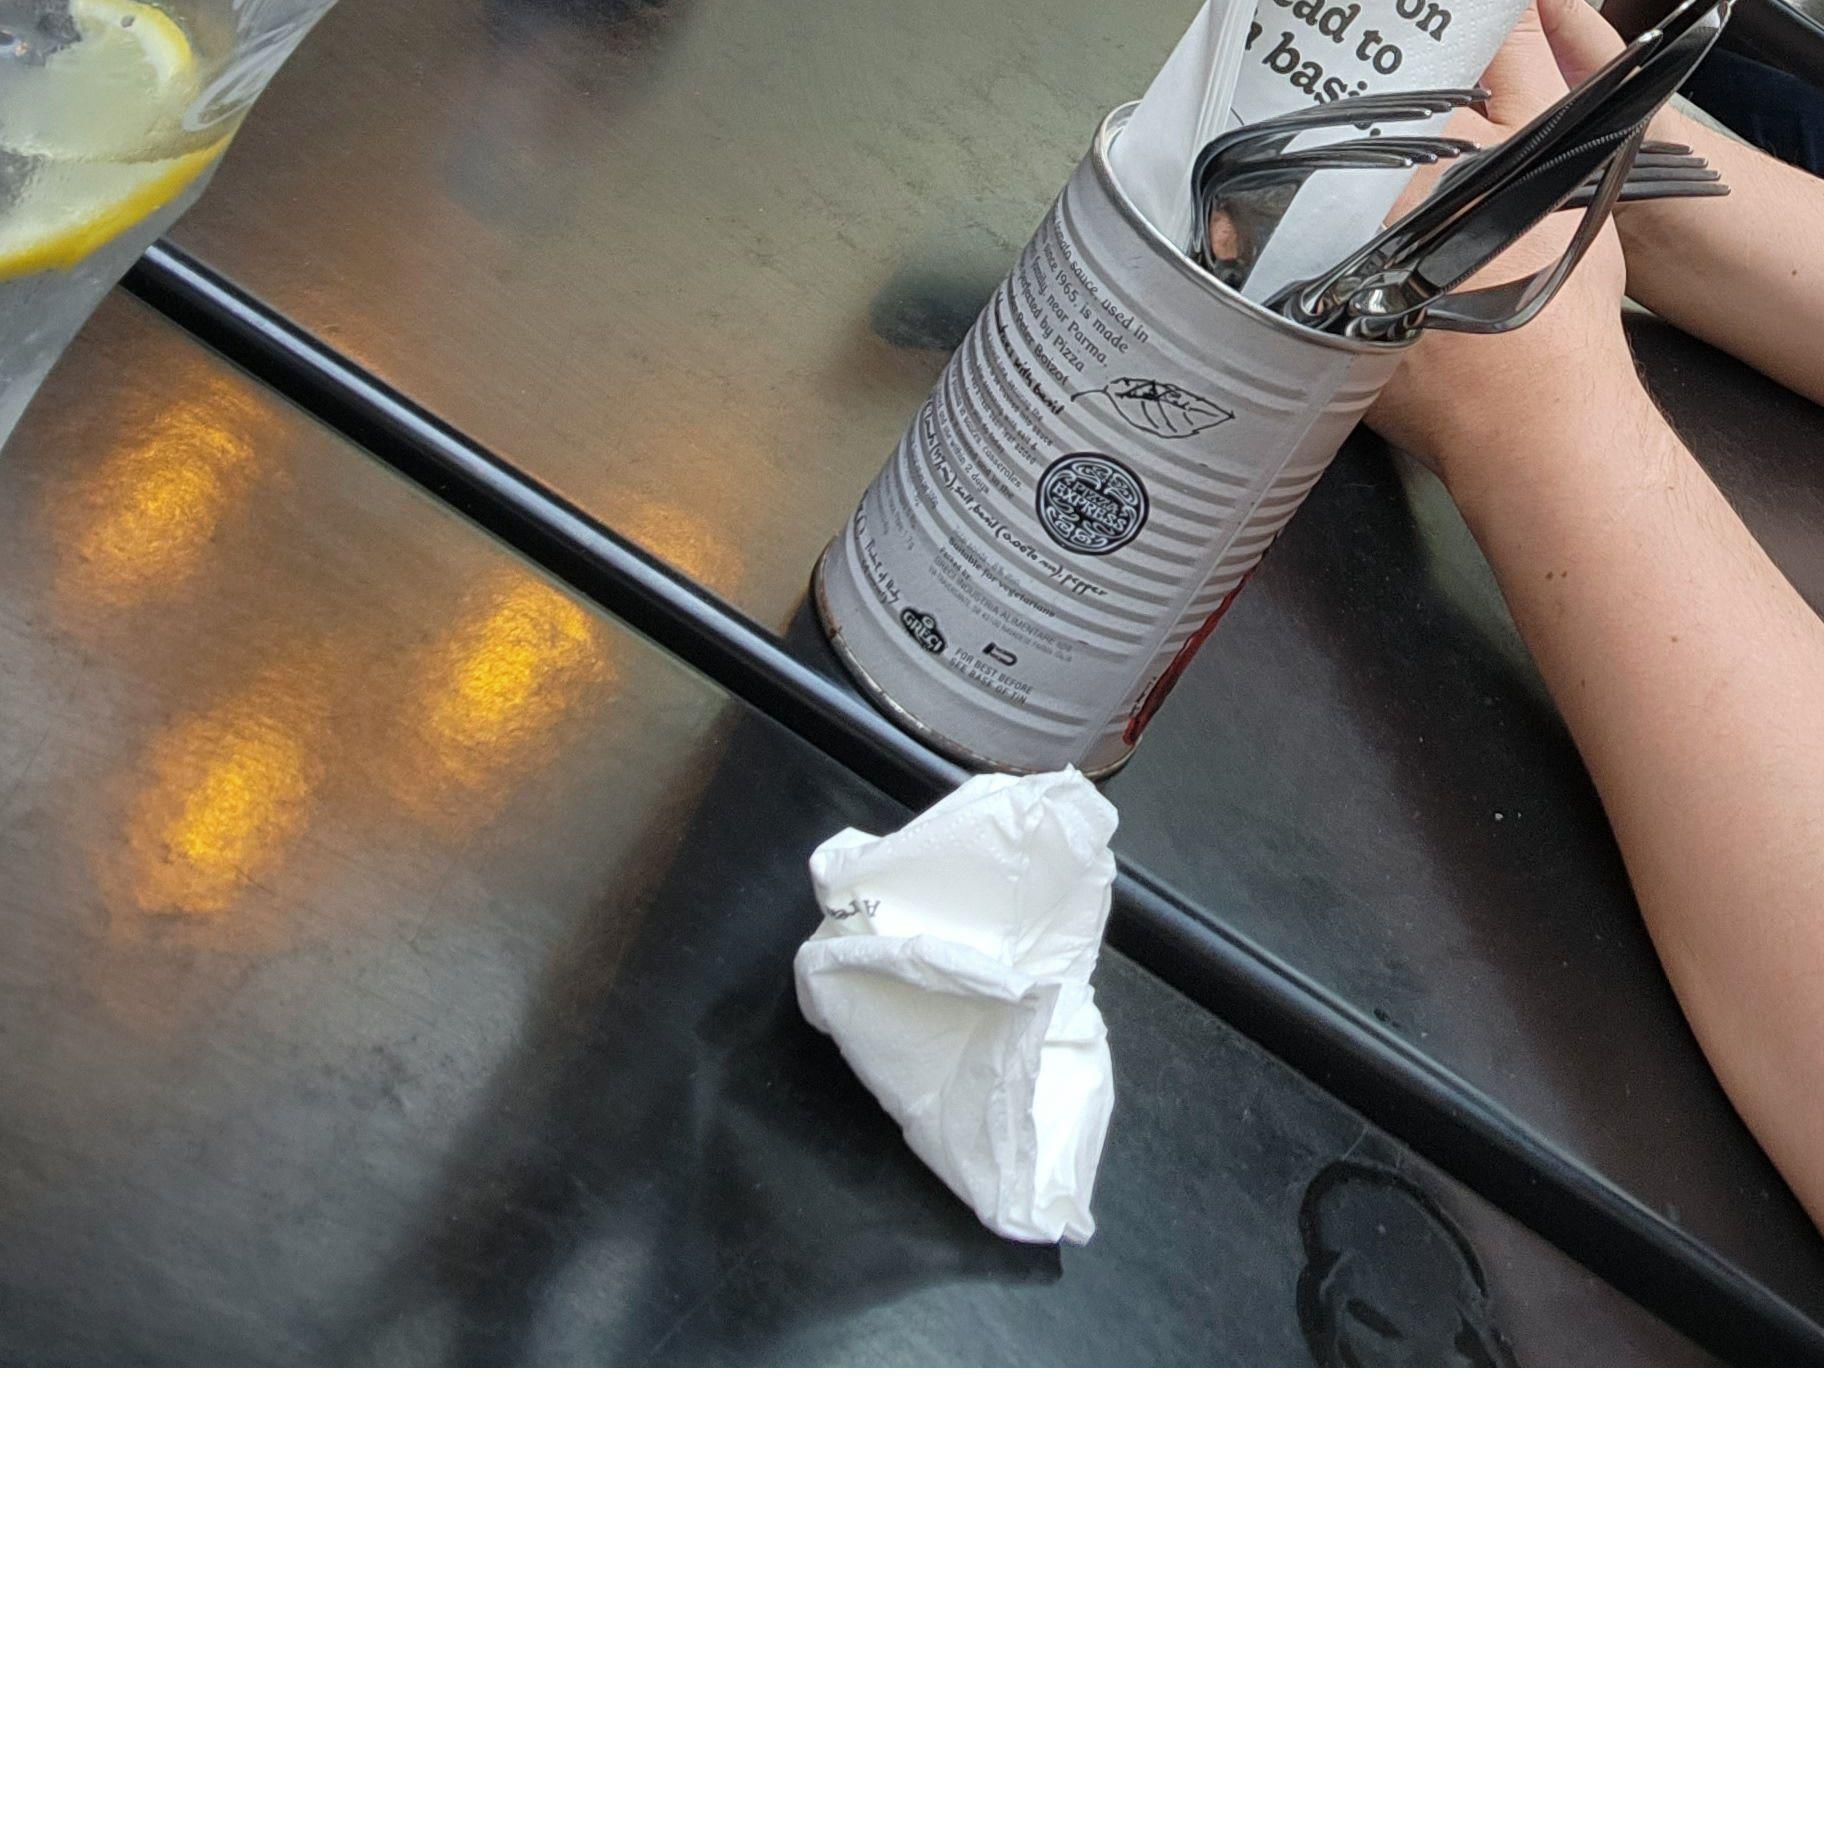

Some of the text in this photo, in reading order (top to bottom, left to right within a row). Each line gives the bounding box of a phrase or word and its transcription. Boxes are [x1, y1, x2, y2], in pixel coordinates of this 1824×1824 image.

[1355, 30, 1403, 75] to
[1045, 295, 1068, 322] near
[1079, 302, 1093, 320] is
[1092, 317, 1129, 353] made
[1101, 296, 1134, 328] used
[1133, 325, 1151, 343] in
[1015, 312, 1068, 384] Peter Boizot
[1039, 317, 1053, 339] by
[1052, 335, 1085, 370] Pizza
[1013, 356, 1035, 385] with
[1031, 384, 1064, 415] basil
[963, 464, 973, 474] 2
[1053, 482, 1127, 531] EXPRESS
[1072, 481, 1119, 514] PIZZA
[948, 536, 981, 569] Suitable
[981, 567, 997, 582] for
[1000, 582, 1053, 617] vegetarians
[903, 612, 941, 651] GRECI
[949, 658, 1026, 705] SEE BASE OF TIN
[955, 647, 1033, 695] FOR BEST BEFORE
